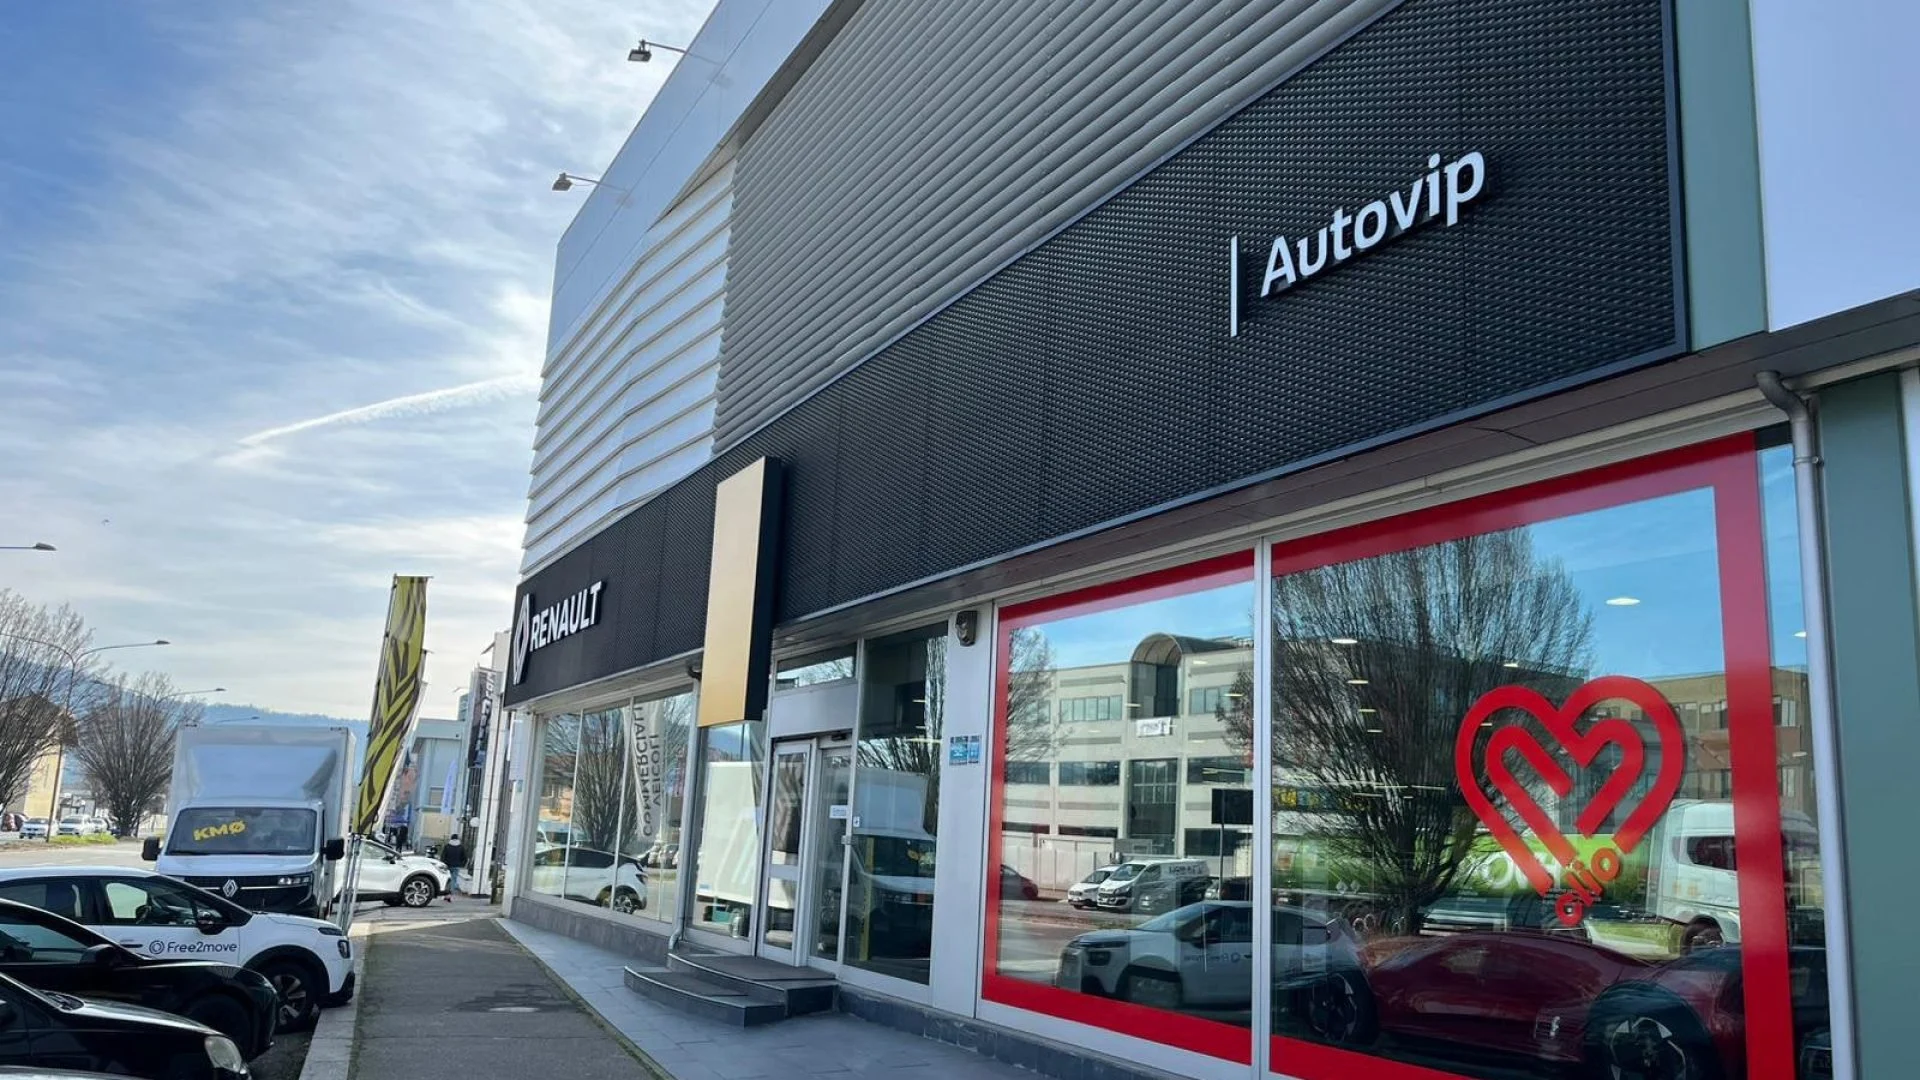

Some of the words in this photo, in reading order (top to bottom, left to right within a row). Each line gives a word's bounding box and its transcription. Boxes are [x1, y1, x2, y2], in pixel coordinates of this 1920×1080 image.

[1260, 151, 1485, 298] Autovip
[529, 580, 602, 652] RENAULT
[167, 940, 238, 953] Free2move
